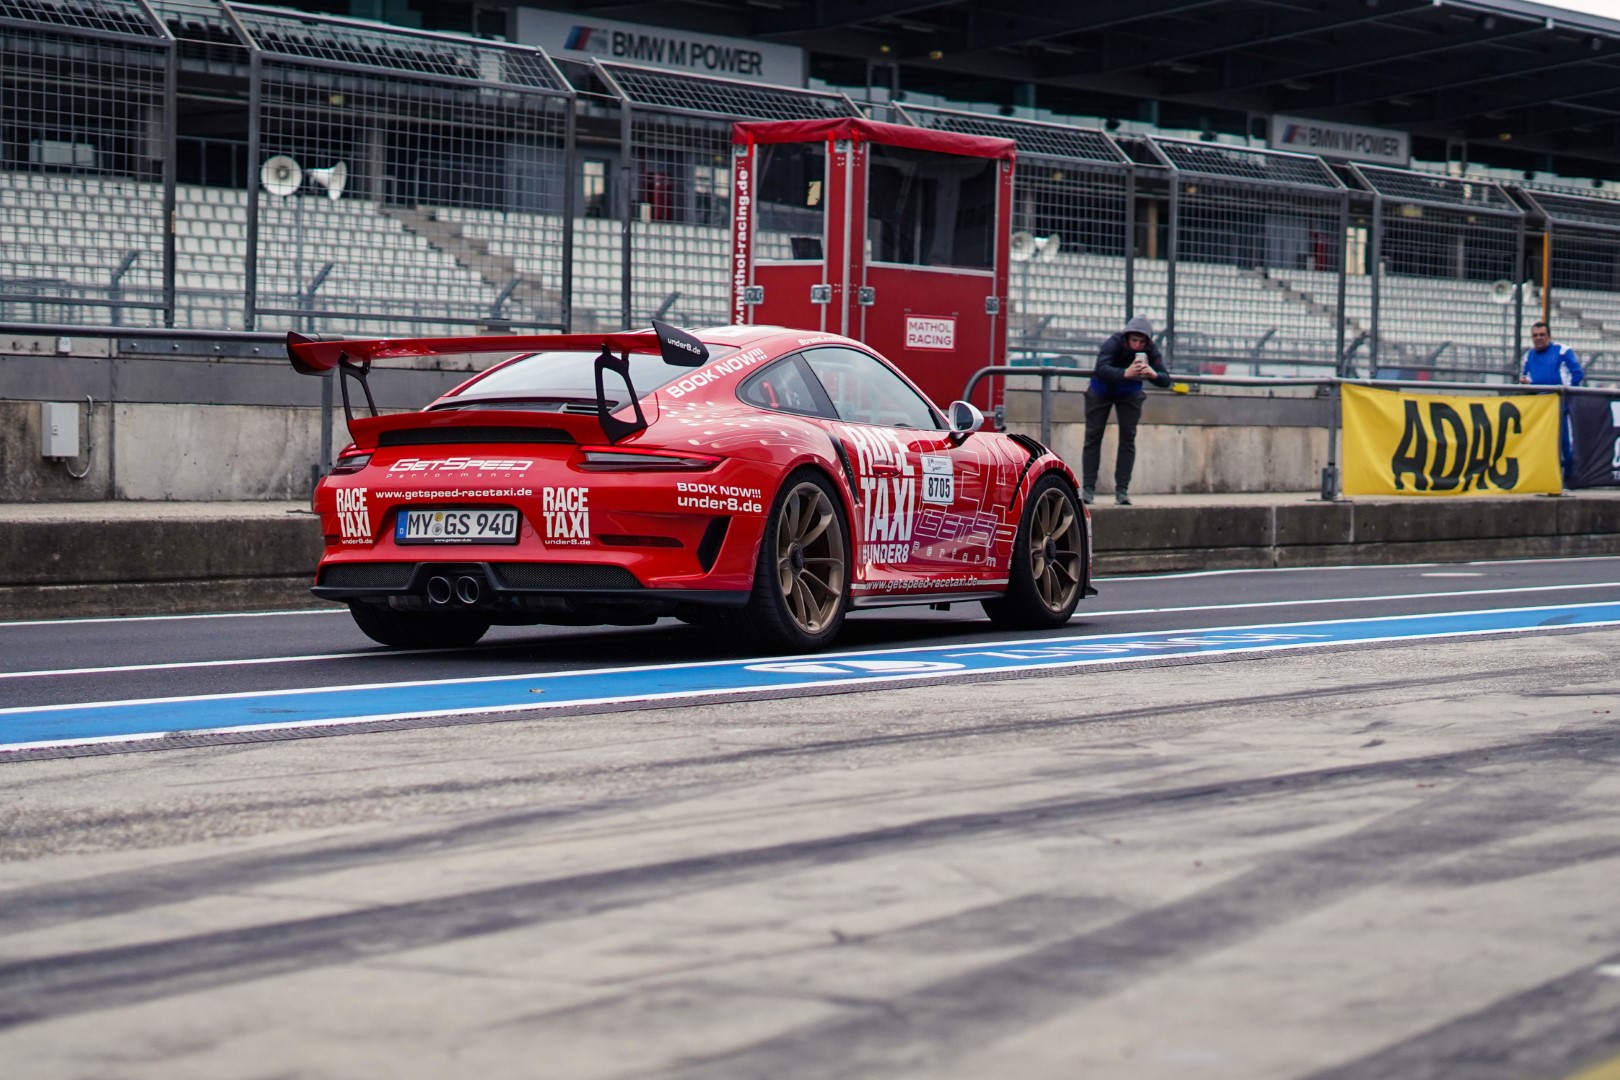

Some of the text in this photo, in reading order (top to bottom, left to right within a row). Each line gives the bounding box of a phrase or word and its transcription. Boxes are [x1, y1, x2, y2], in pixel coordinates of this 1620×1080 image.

[611, 31, 763, 76] BMW M POWER
[1308, 127, 1339, 150] BMW
[1355, 133, 1399, 156] POWER
[909, 321, 952, 333] MATHOL
[667, 338, 701, 355] under8.de
[908, 334, 952, 345] RACING
[665, 347, 768, 398] BOOK NOW!!!
[1391, 399, 1522, 492] ADAC
[335, 487, 368, 511] RACE
[375, 487, 533, 500] www.getspeed-racetaxi.de
[676, 482, 762, 499] BOOK NOW!!!
[928, 477, 951, 498] 8705
[542, 487, 589, 512] RACE
[677, 496, 763, 513] under8.de
[860, 477, 915, 541] TAXI
[337, 511, 372, 538] TAXI
[407, 513, 434, 535] MY
[444, 513, 471, 535] GS
[476, 513, 515, 536] 940
[542, 511, 590, 538] TAXI
[862, 543, 910, 565] #UNDER8
[865, 575, 978, 593] www.getspeed-racetaxi.de
